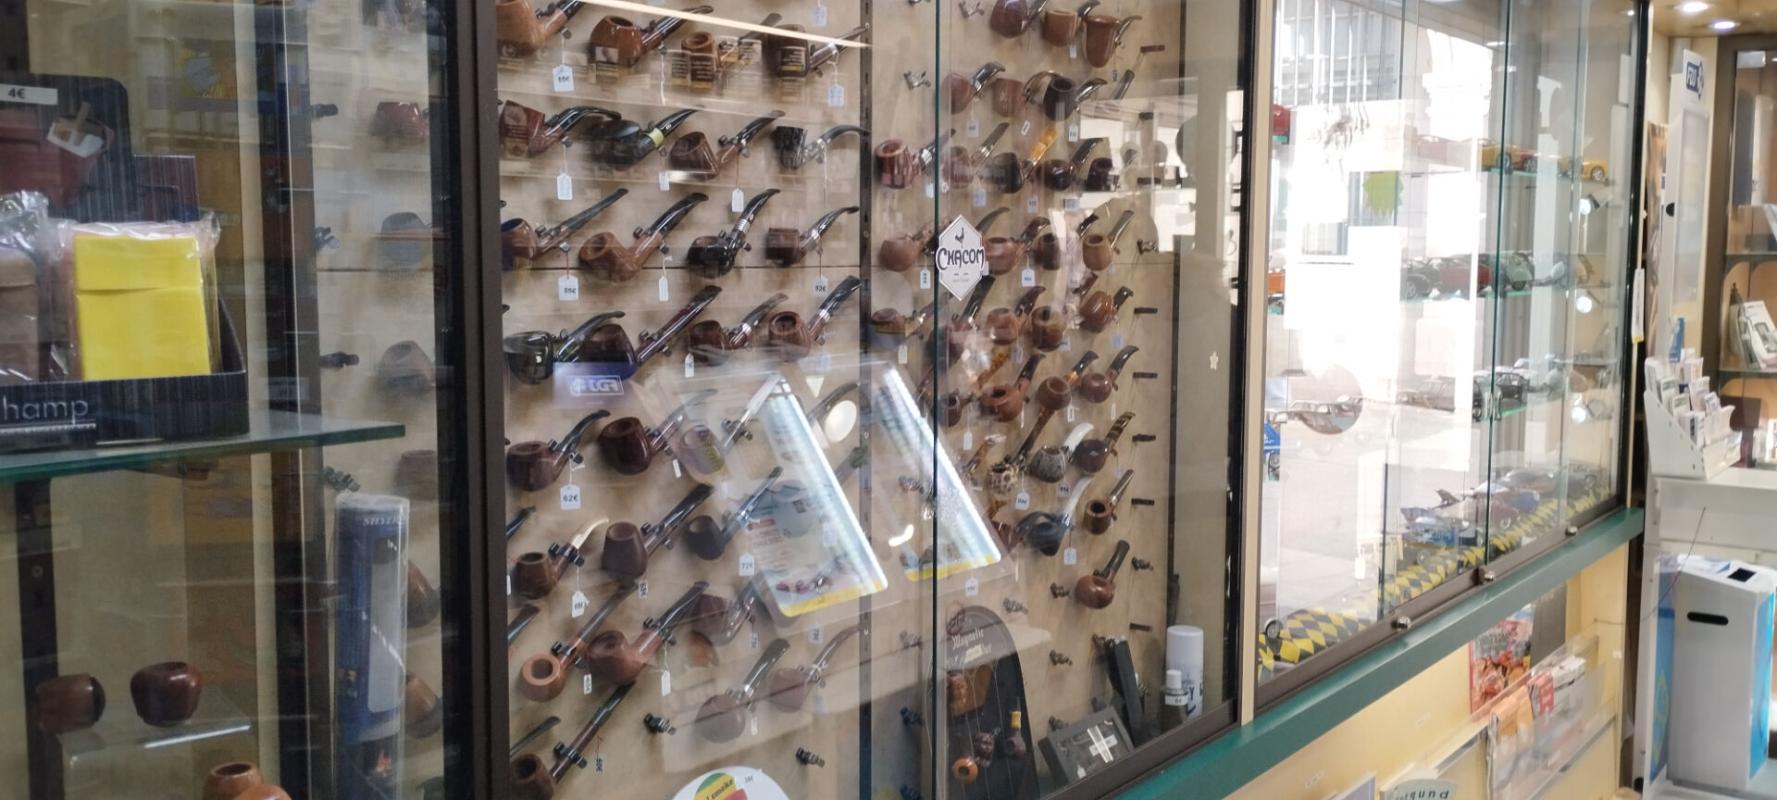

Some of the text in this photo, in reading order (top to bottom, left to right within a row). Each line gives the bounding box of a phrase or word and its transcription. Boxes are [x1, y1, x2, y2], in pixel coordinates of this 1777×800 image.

[7, 88, 26, 100] 4€
[937, 247, 984, 271] CHACOM
[2, 396, 88, 425] hamp
[562, 493, 578, 503] 62€
